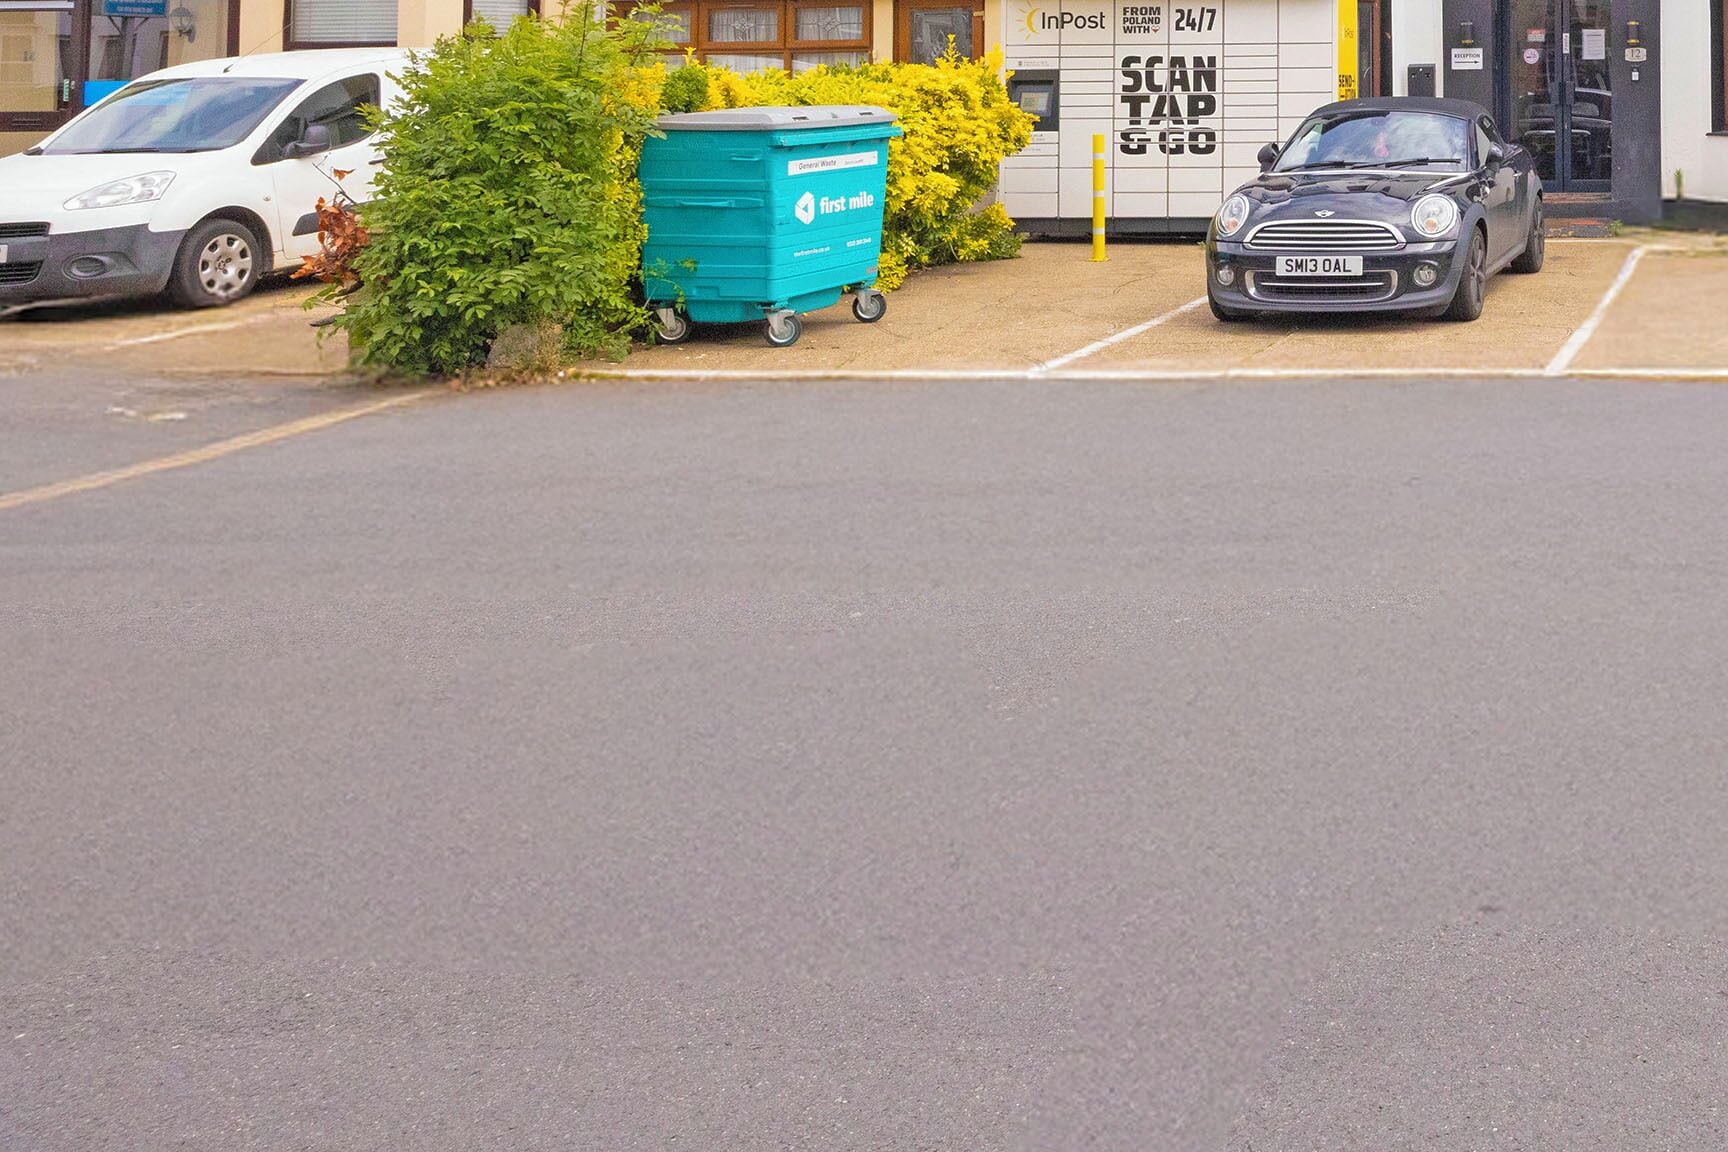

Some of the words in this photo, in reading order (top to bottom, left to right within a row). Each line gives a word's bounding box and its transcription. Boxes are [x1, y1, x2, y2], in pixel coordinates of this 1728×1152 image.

[1122, 6, 1161, 16] FROM
[1041, 11, 1105, 29] InPost
[1122, 16, 1161, 25] POLAND
[1175, 7, 1216, 33] 24/7
[1122, 25, 1150, 34] WITH
[1631, 49, 1641, 58] 12
[1121, 56, 1217, 93] SCAN
[1121, 94, 1217, 126] TAP
[1158, 127, 1217, 155] GO
[798, 161, 819, 170] General
[821, 159, 836, 167] Waste
[820, 196, 846, 214] first
[849, 191, 874, 210] mile
[1285, 258, 1318, 273] SM13
[1322, 258, 1351, 273] OAL
